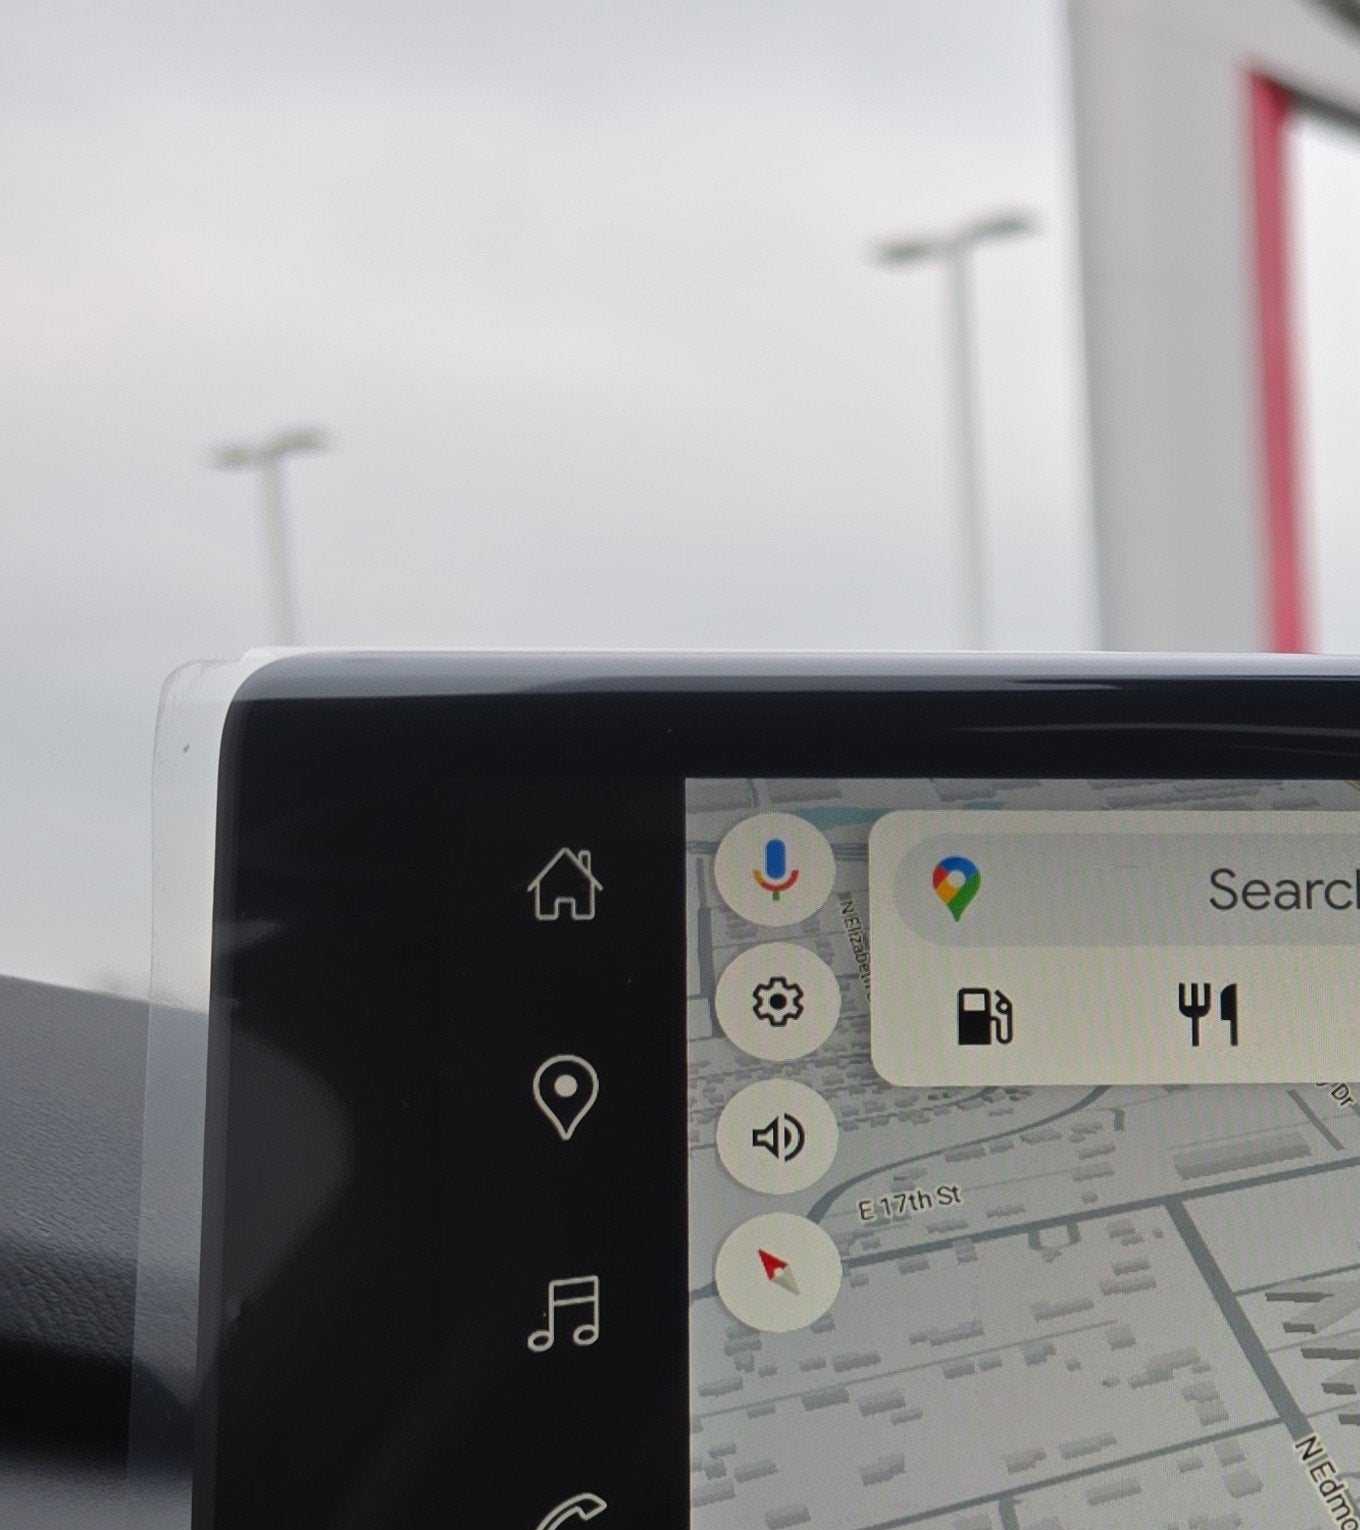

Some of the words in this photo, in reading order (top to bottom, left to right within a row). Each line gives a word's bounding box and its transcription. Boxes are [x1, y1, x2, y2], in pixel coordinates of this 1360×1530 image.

[1331, 1083, 1354, 1107] Dr
[860, 1199, 876, 1220] E
[881, 1189, 933, 1216] 17th
[936, 1184, 962, 1206] St
[1296, 1435, 1323, 1462] N
